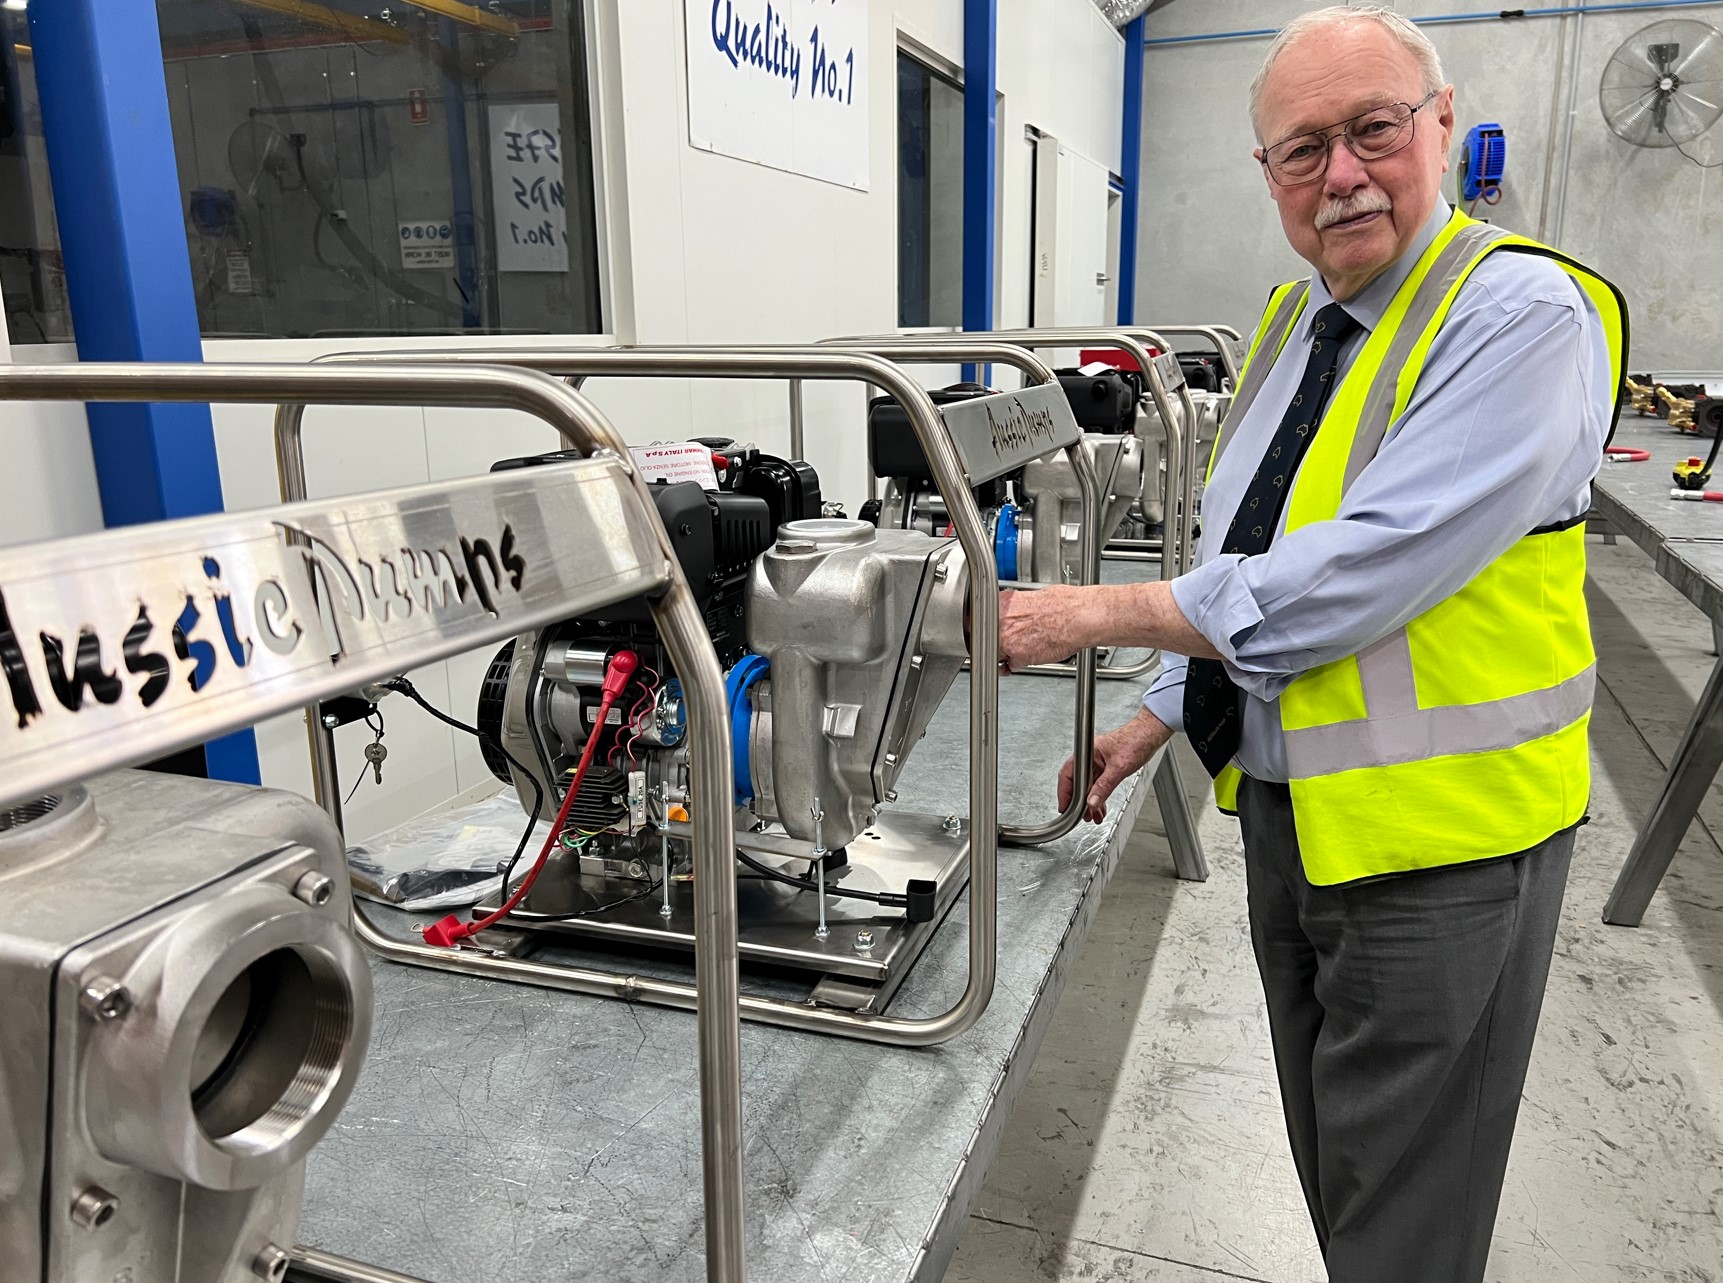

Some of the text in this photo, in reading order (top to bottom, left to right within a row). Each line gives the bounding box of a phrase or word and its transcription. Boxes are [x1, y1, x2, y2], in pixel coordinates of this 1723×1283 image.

[711, 0, 854, 105] Quality No.1
[985, 396, 1055, 463] Aussie Pumps
[272, 521, 527, 668] Pumps
